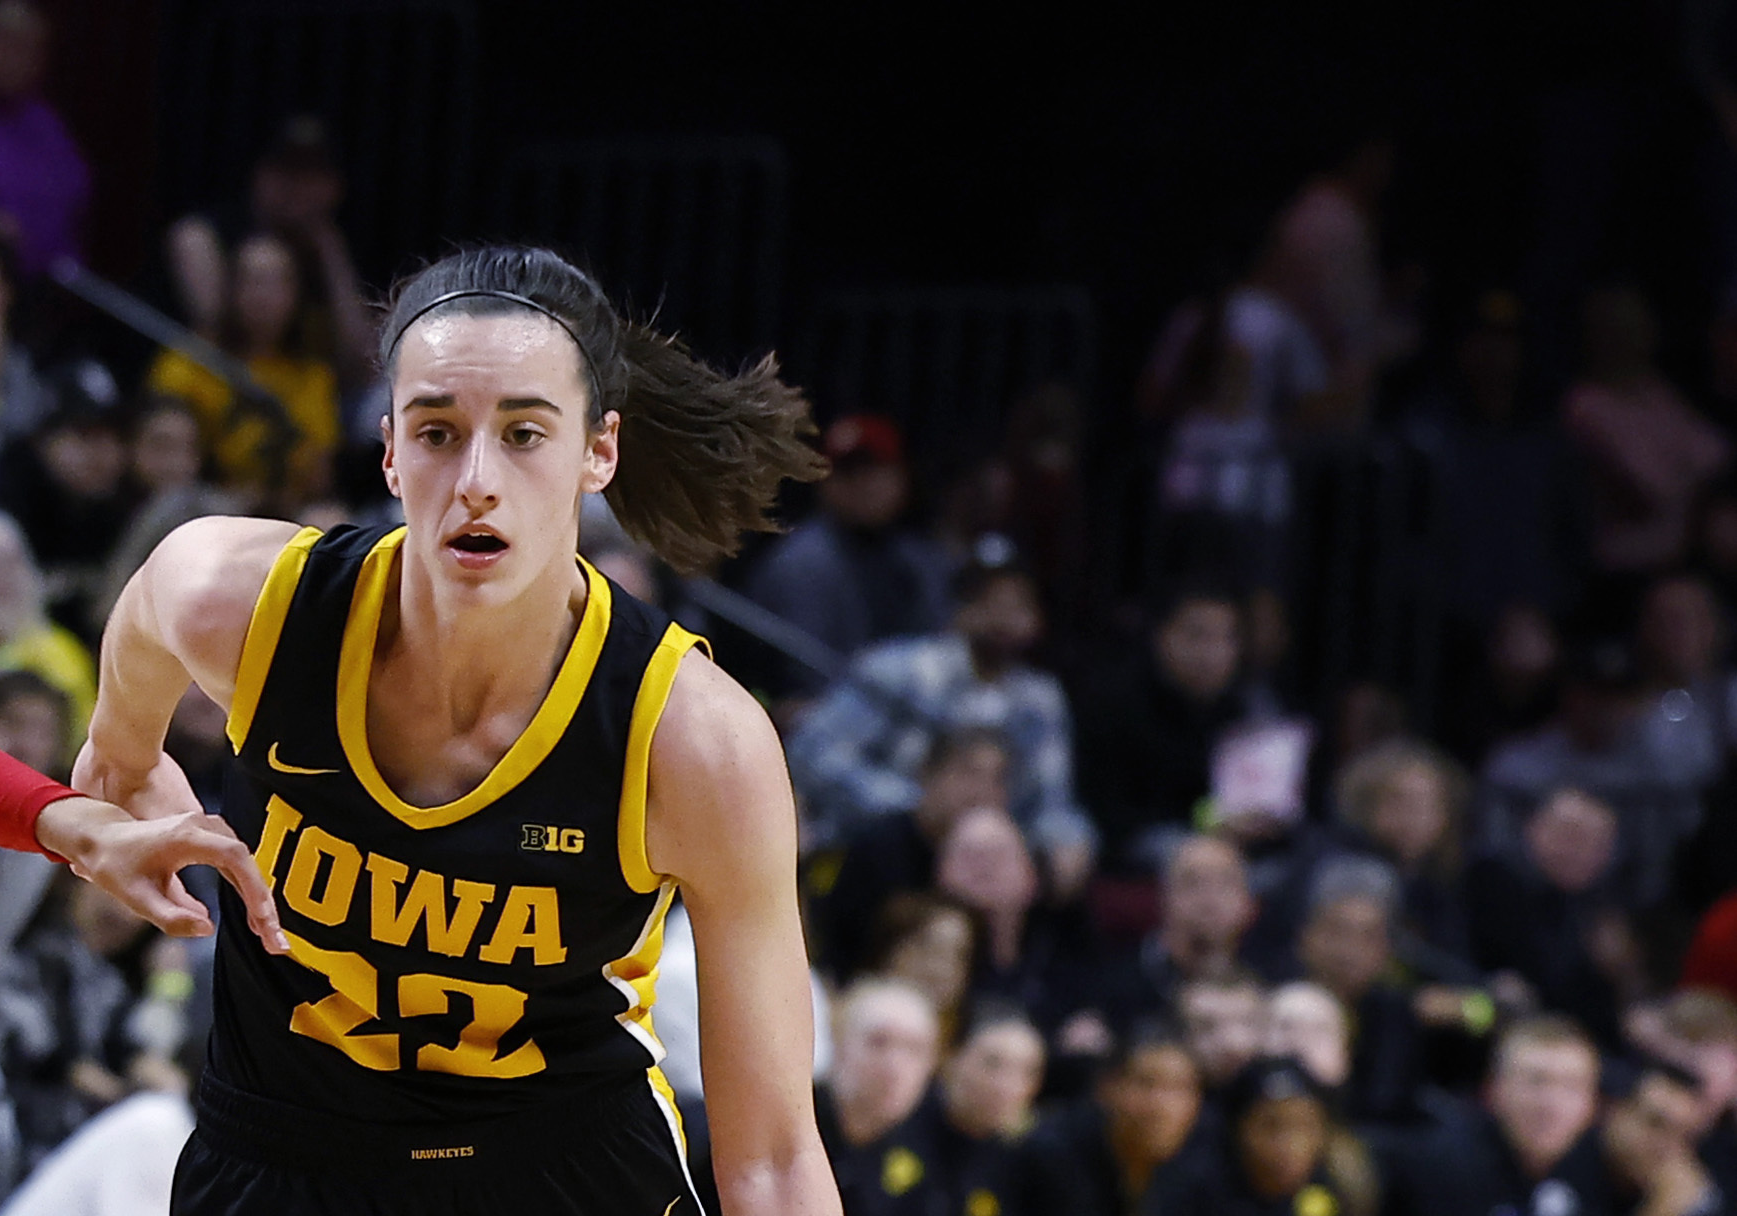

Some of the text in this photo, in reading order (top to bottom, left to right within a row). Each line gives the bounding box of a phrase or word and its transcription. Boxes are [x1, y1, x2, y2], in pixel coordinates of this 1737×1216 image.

[253, 793, 567, 966] IOWA
[283, 931, 548, 1079] 22
[410, 1145, 475, 1160] HAWKEYES
